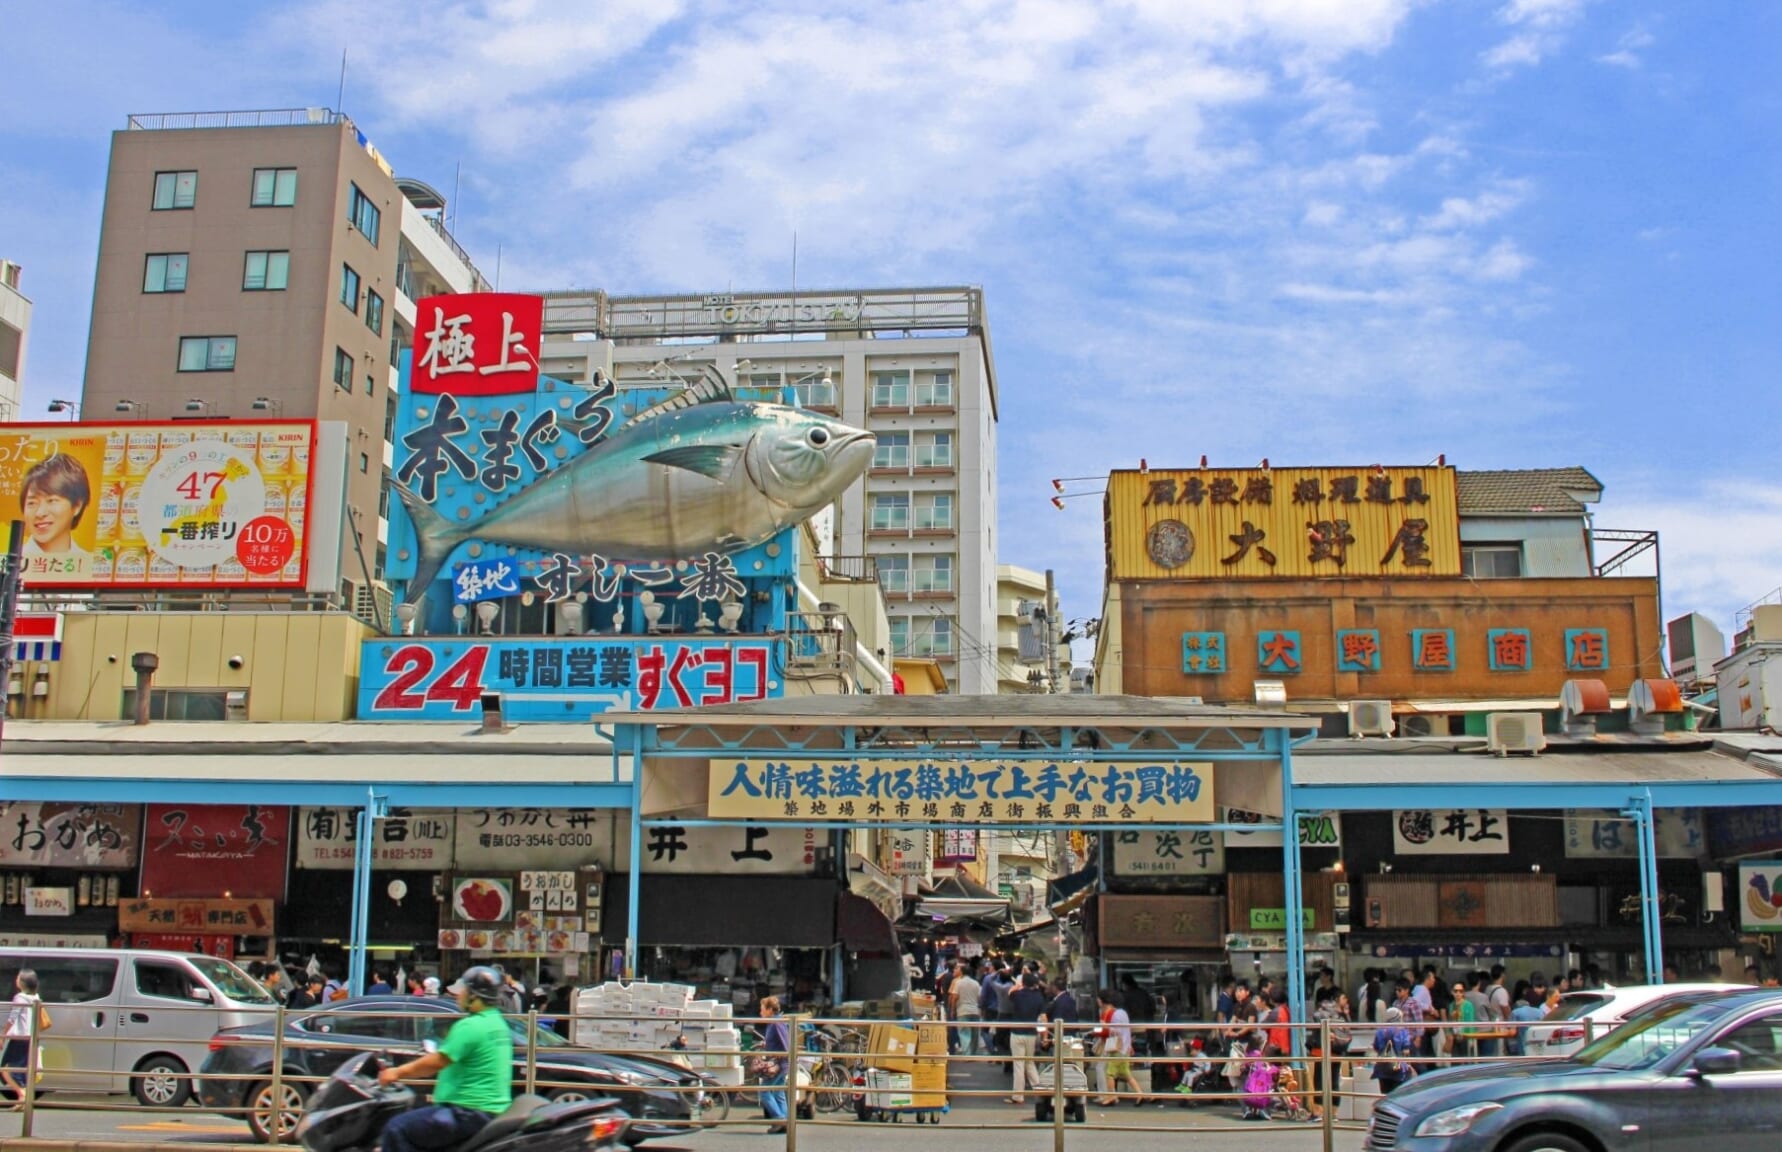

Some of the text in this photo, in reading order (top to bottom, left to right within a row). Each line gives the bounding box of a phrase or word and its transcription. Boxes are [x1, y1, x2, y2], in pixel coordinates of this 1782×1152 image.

[703, 296, 735, 305] HOTEL
[800, 297, 868, 322] STAY
[418, 307, 532, 380] 極上
[69, 438, 94, 446] KIRIN
[278, 434, 304, 442] KIRIN
[397, 367, 618, 503] 本まぐろ
[176, 471, 228, 499] 47
[161, 521, 237, 541] 一番搾り
[243, 524, 289, 544] 10万
[1220, 518, 1432, 567] 大野屋
[456, 562, 518, 601] 築地
[535, 553, 747, 604] すし一番
[719, 762, 1202, 804] 人情味溢れる築地で上手なお買物
[784, 801, 1137, 820] 築地場外市場商店街振興組合
[1440, 809, 1503, 842] 井上
[12, 813, 121, 851] おかめ
[647, 817, 773, 862] 井上
